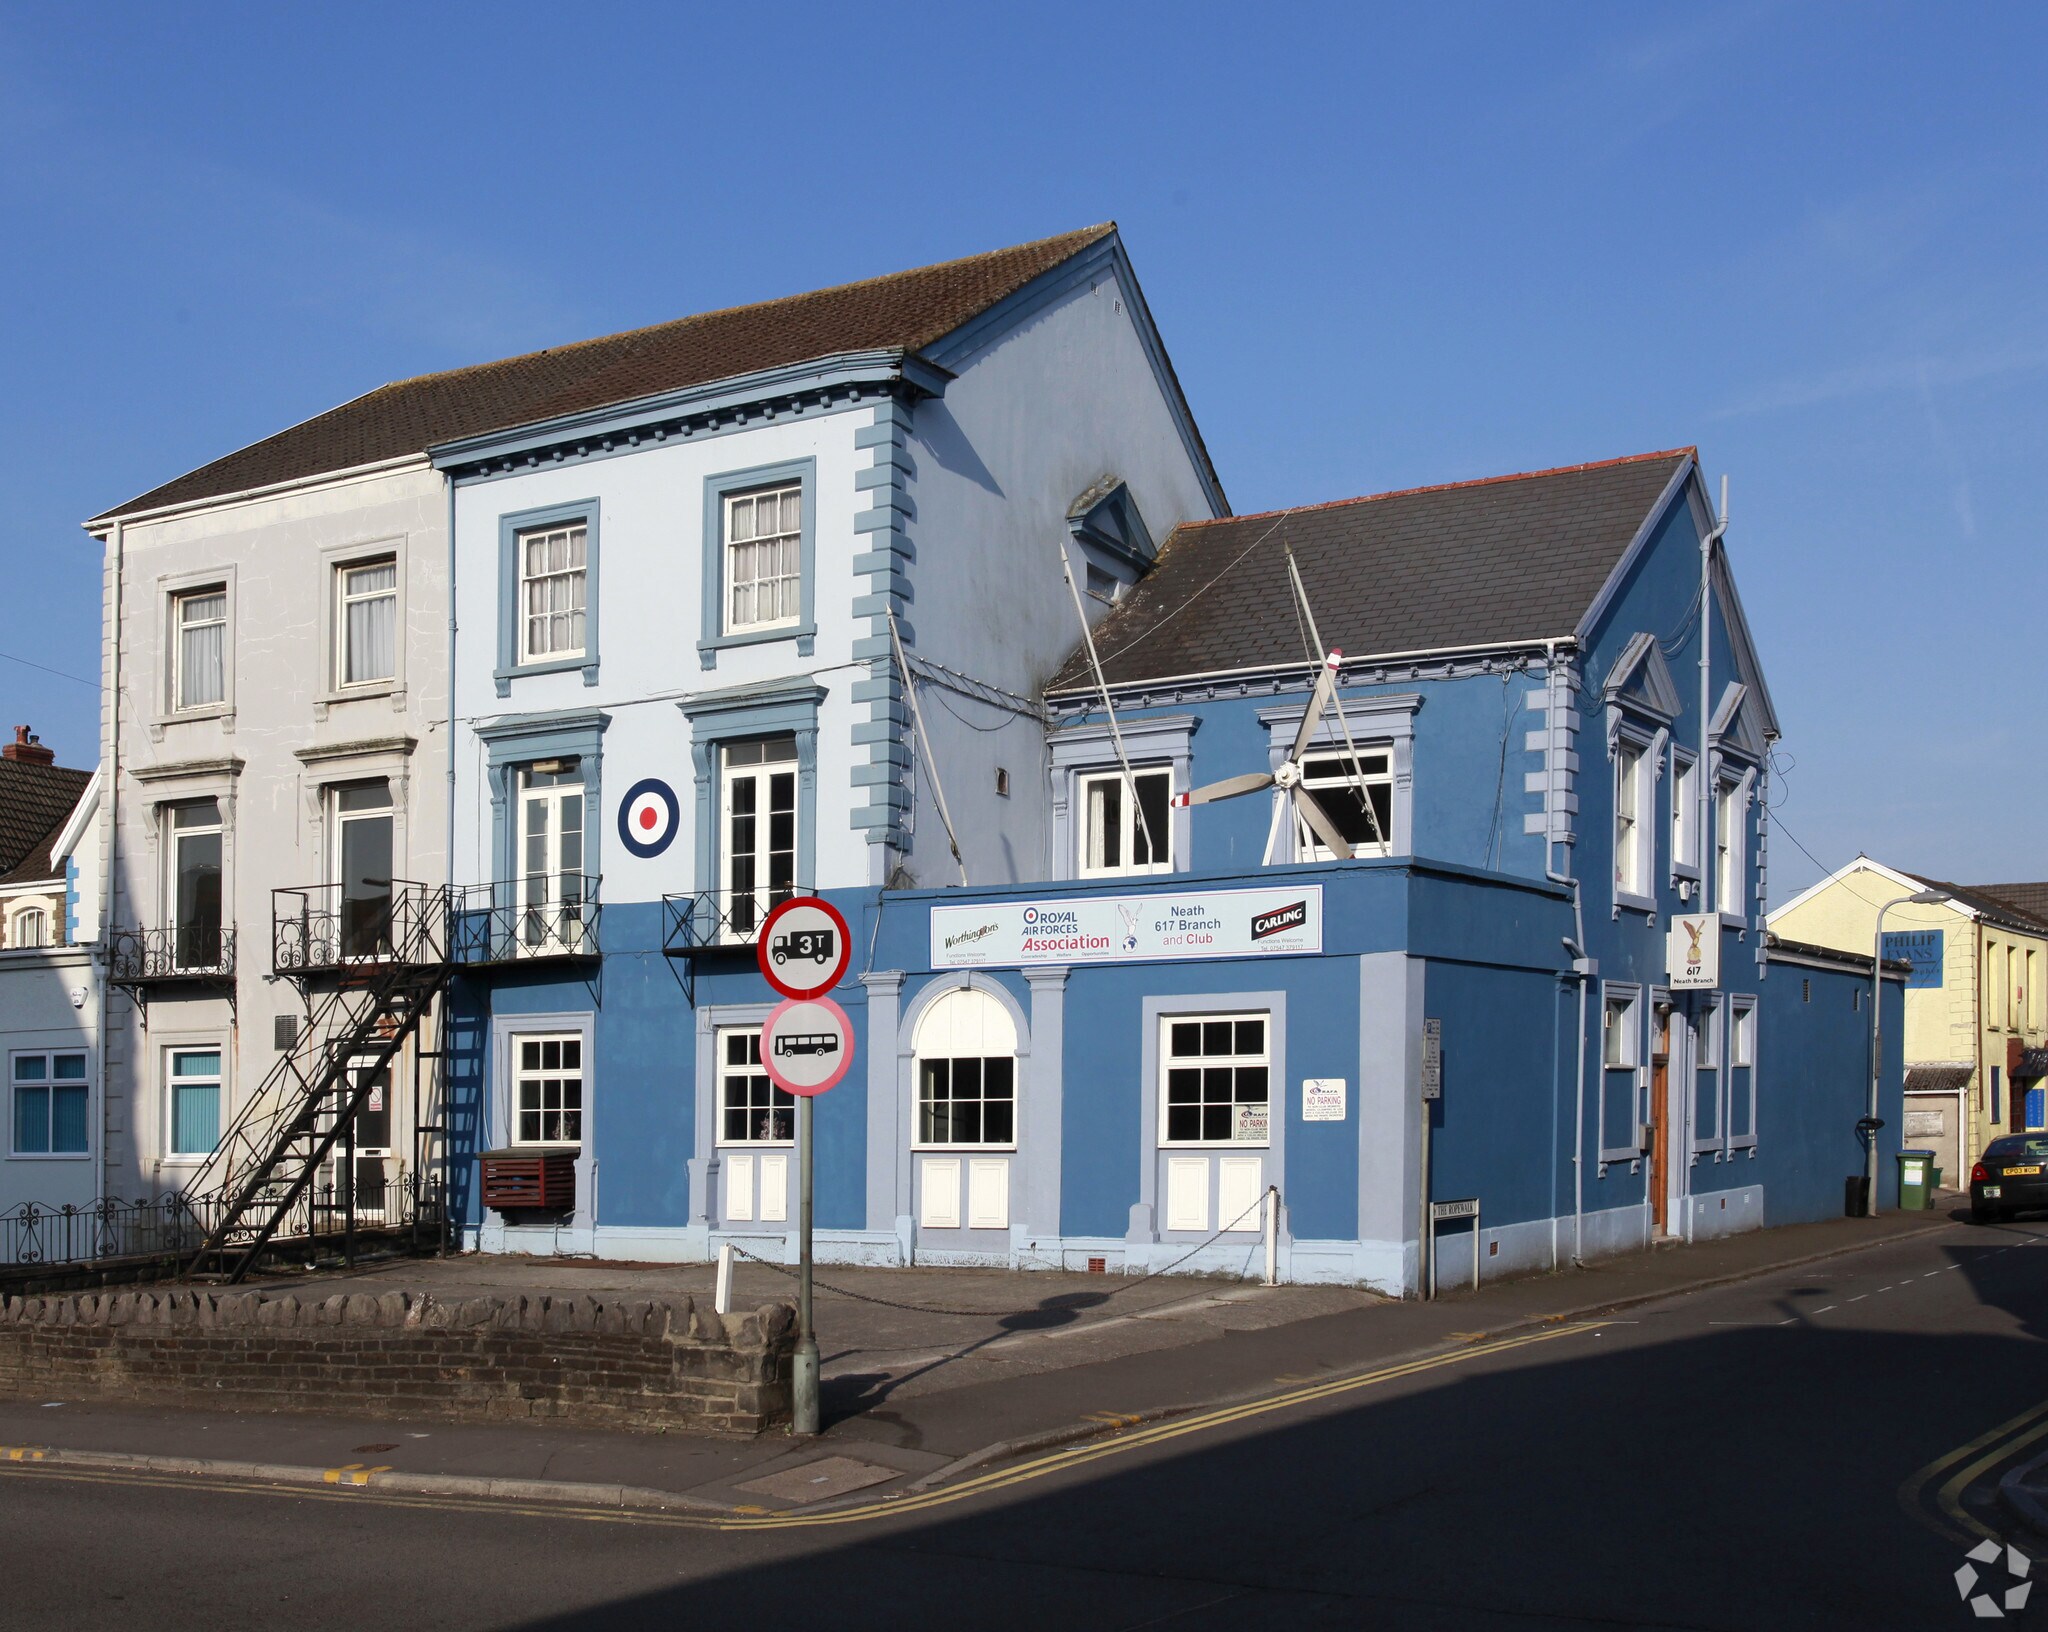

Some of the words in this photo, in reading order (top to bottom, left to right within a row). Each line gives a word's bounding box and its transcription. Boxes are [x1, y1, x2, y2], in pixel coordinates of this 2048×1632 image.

[1171, 905, 1205, 917] Neath
[1040, 911, 1078, 924] ROYAL
[1255, 908, 1303, 933] CARLING
[1021, 926, 1038, 936] AIR
[1040, 924, 1078, 934] FORCES
[1155, 920, 1174, 932] 617
[1179, 919, 1221, 931] Branch
[1021, 934, 1110, 951] Association
[1163, 935, 1183, 946] and
[1186, 933, 1213, 944] Club
[1885, 935, 1936, 947] PHILIP
[1887, 949, 1932, 960] EVANS
[1686, 966, 1701, 976] 617
[1307, 1096, 1315, 1105] NO
[1318, 1096, 1341, 1105] PARKING
[1240, 1120, 1247, 1128] NO
[1438, 1205, 1447, 1216] THE
[1449, 1202, 1474, 1215] ROPEWALK
